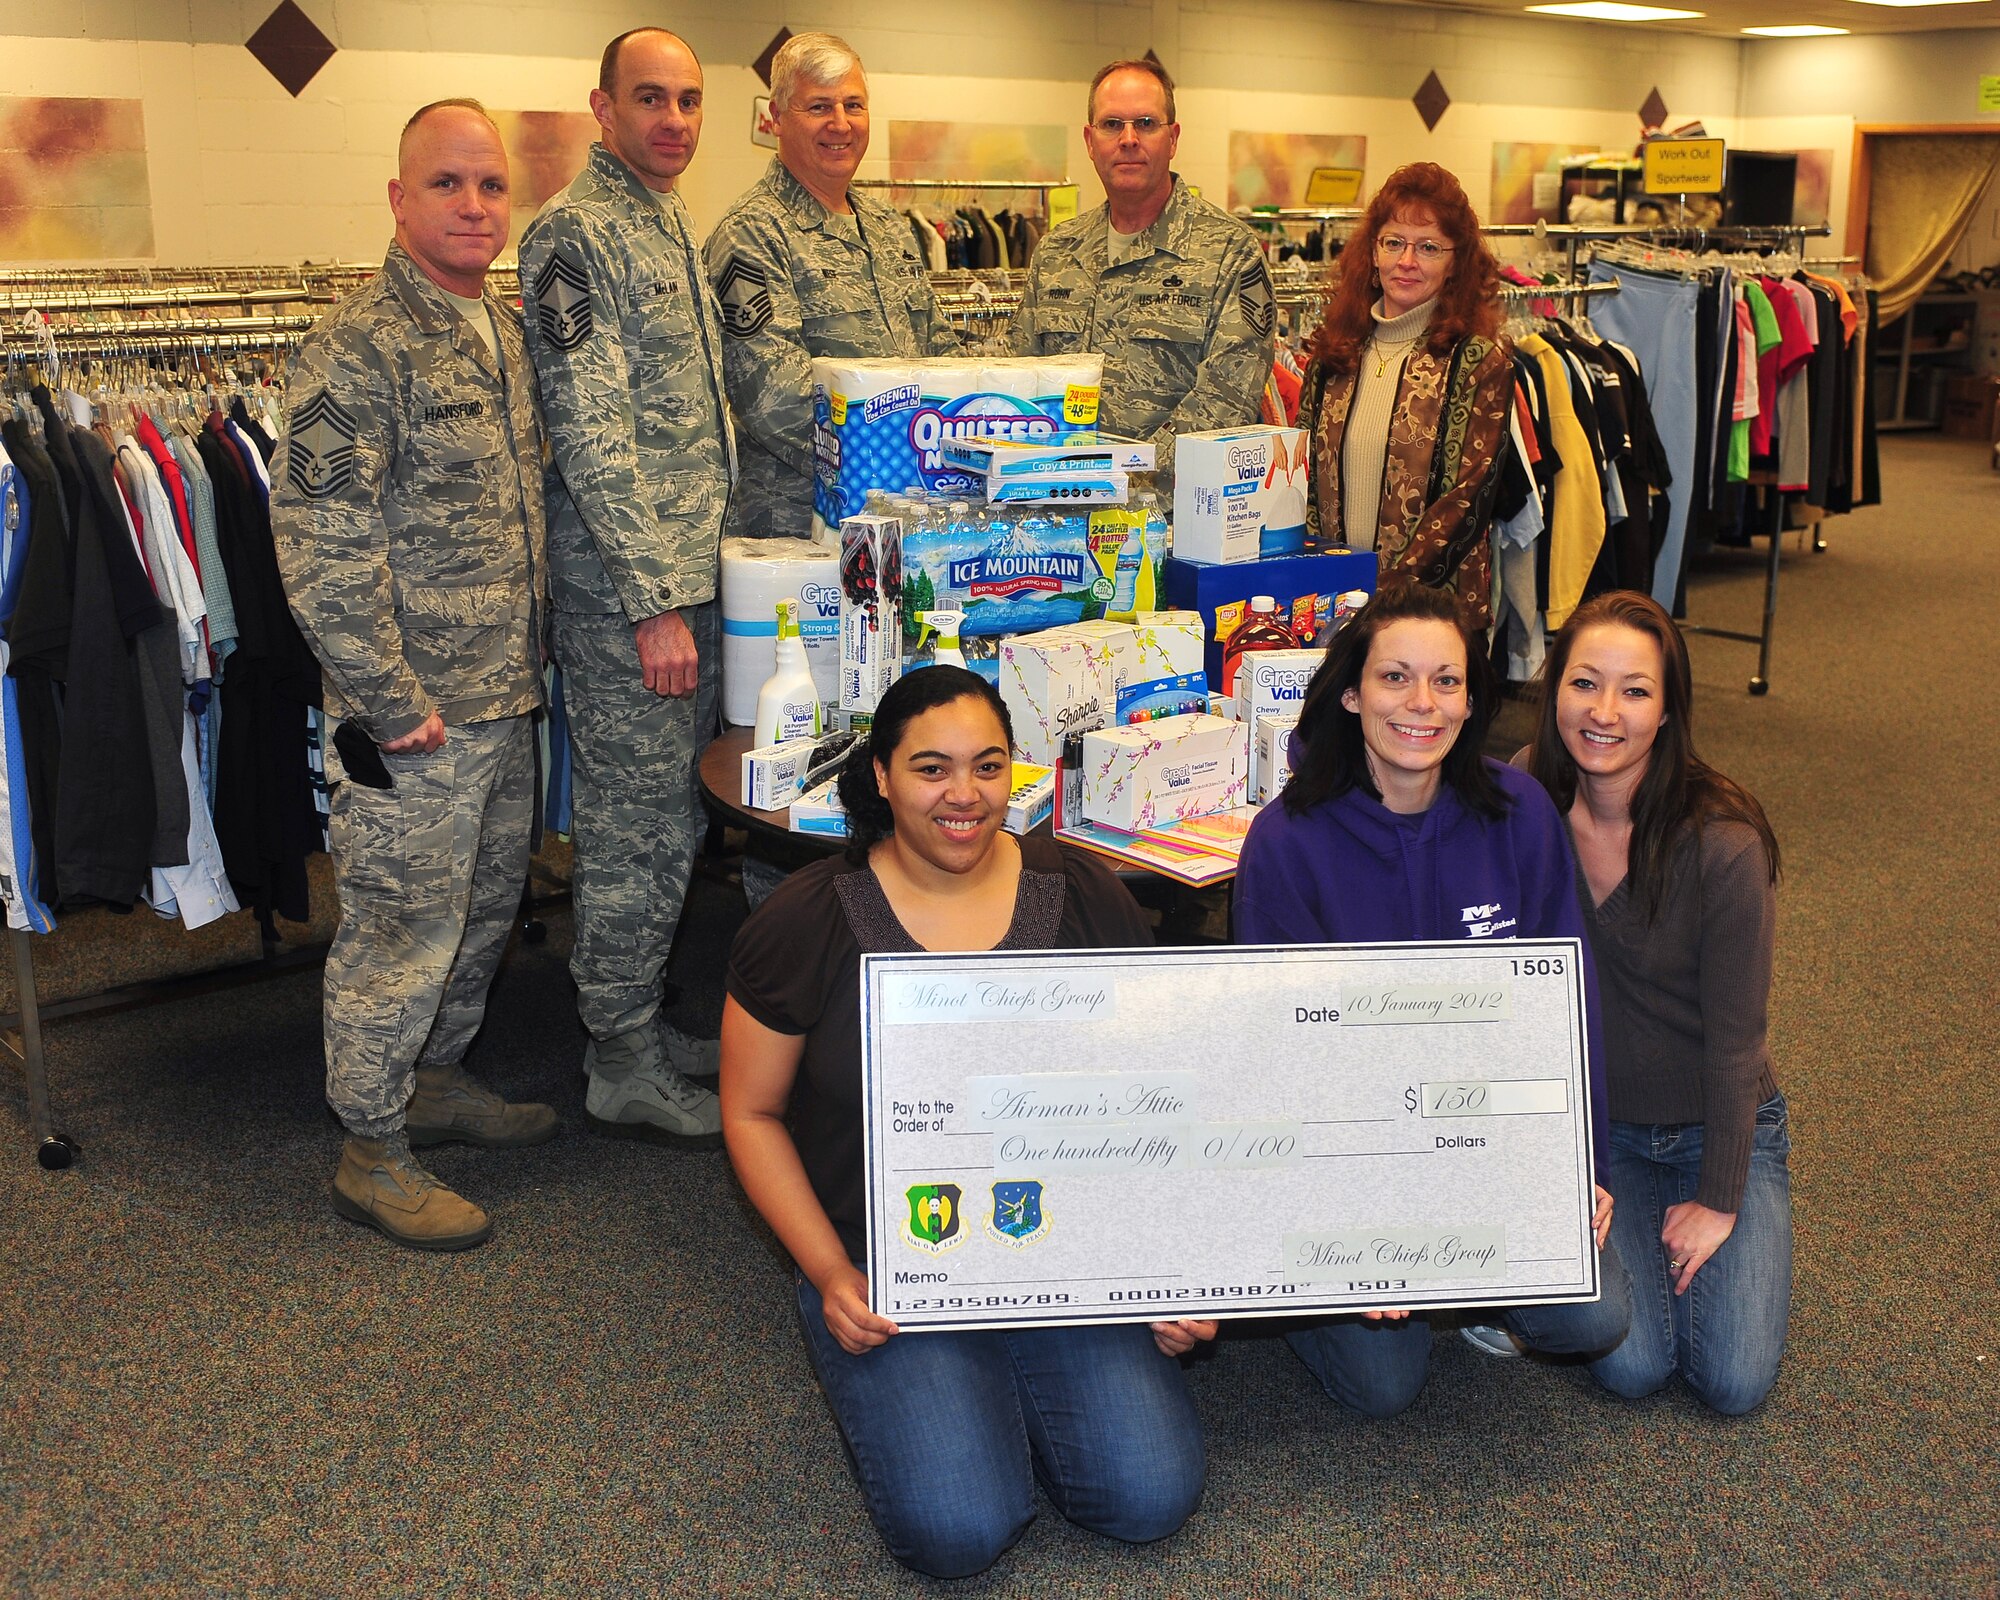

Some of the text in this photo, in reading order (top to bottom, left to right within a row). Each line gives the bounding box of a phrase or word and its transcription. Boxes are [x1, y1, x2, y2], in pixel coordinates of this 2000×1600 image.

[1659, 149, 1711, 159] Work Out
[1155, 294, 1169, 304] AIR
[1171, 294, 1202, 308] FORCE
[866, 385, 919, 414] STRENGTH
[1067, 389, 1080, 402] 24
[424, 401, 484, 421] HANSFORD
[867, 411, 878, 421] You
[880, 405, 891, 415] Can
[891, 400, 909, 410] Count
[1228, 443, 1266, 468] Great
[1032, 461, 1058, 473] Copy
[1059, 460, 1068, 470] &
[1069, 459, 1095, 470] Print
[1237, 465, 1265, 480] Value
[1227, 502, 1248, 512] 100 Tall
[1227, 510, 1262, 522] Kitchen Bags
[1091, 524, 1106, 535] 24
[1101, 533, 1130, 543] BOTTLES
[954, 561, 981, 583] ICE
[985, 557, 1079, 577] MOUNTAIN
[801, 582, 841, 605] Gre
[973, 585, 993, 594] 100%
[995, 582, 1020, 593] NATURAL
[1020, 579, 1041, 587] SPRING
[802, 624, 833, 634] Strong
[842, 667, 854, 707] Great
[852, 669, 860, 699] Value
[1118, 690, 1124, 700] 8
[1271, 687, 1307, 700] Valu
[783, 701, 814, 716] Great
[1055, 695, 1100, 736] Sharpie
[1255, 706, 1281, 714] Chewy
[791, 713, 814, 723] Value
[772, 757, 797, 775] Great
[1161, 763, 1190, 781] Great
[1191, 762, 1205, 770] Facial
[777, 770, 795, 780] Value
[1169, 777, 1191, 788] Value
[1510, 959, 1564, 976] 1503
[898, 979, 1106, 1015] Minot Chiefs Group
[1295, 989, 1503, 1023] Date 10 January 2012
[892, 1101, 915, 1117] Pay
[918, 1101, 931, 1115] to
[934, 1099, 954, 1114] the
[1115, 1083, 1185, 1117] Attic
[1404, 1086, 1488, 1114] $ 150
[892, 1117, 944, 1133] Order of
[1435, 1135, 1487, 1149] Dollars
[1000, 1135, 1049, 1162] One
[1052, 1137, 1141, 1161] hundred
[1137, 1135, 1178, 1168] fifty
[986, 1226, 1047, 1249] POISED FOR PEACE
[1296, 1235, 1497, 1270] Minot Chiefs Group
[894, 1271, 948, 1285] Memo
[1347, 1279, 1407, 1292] 1503
